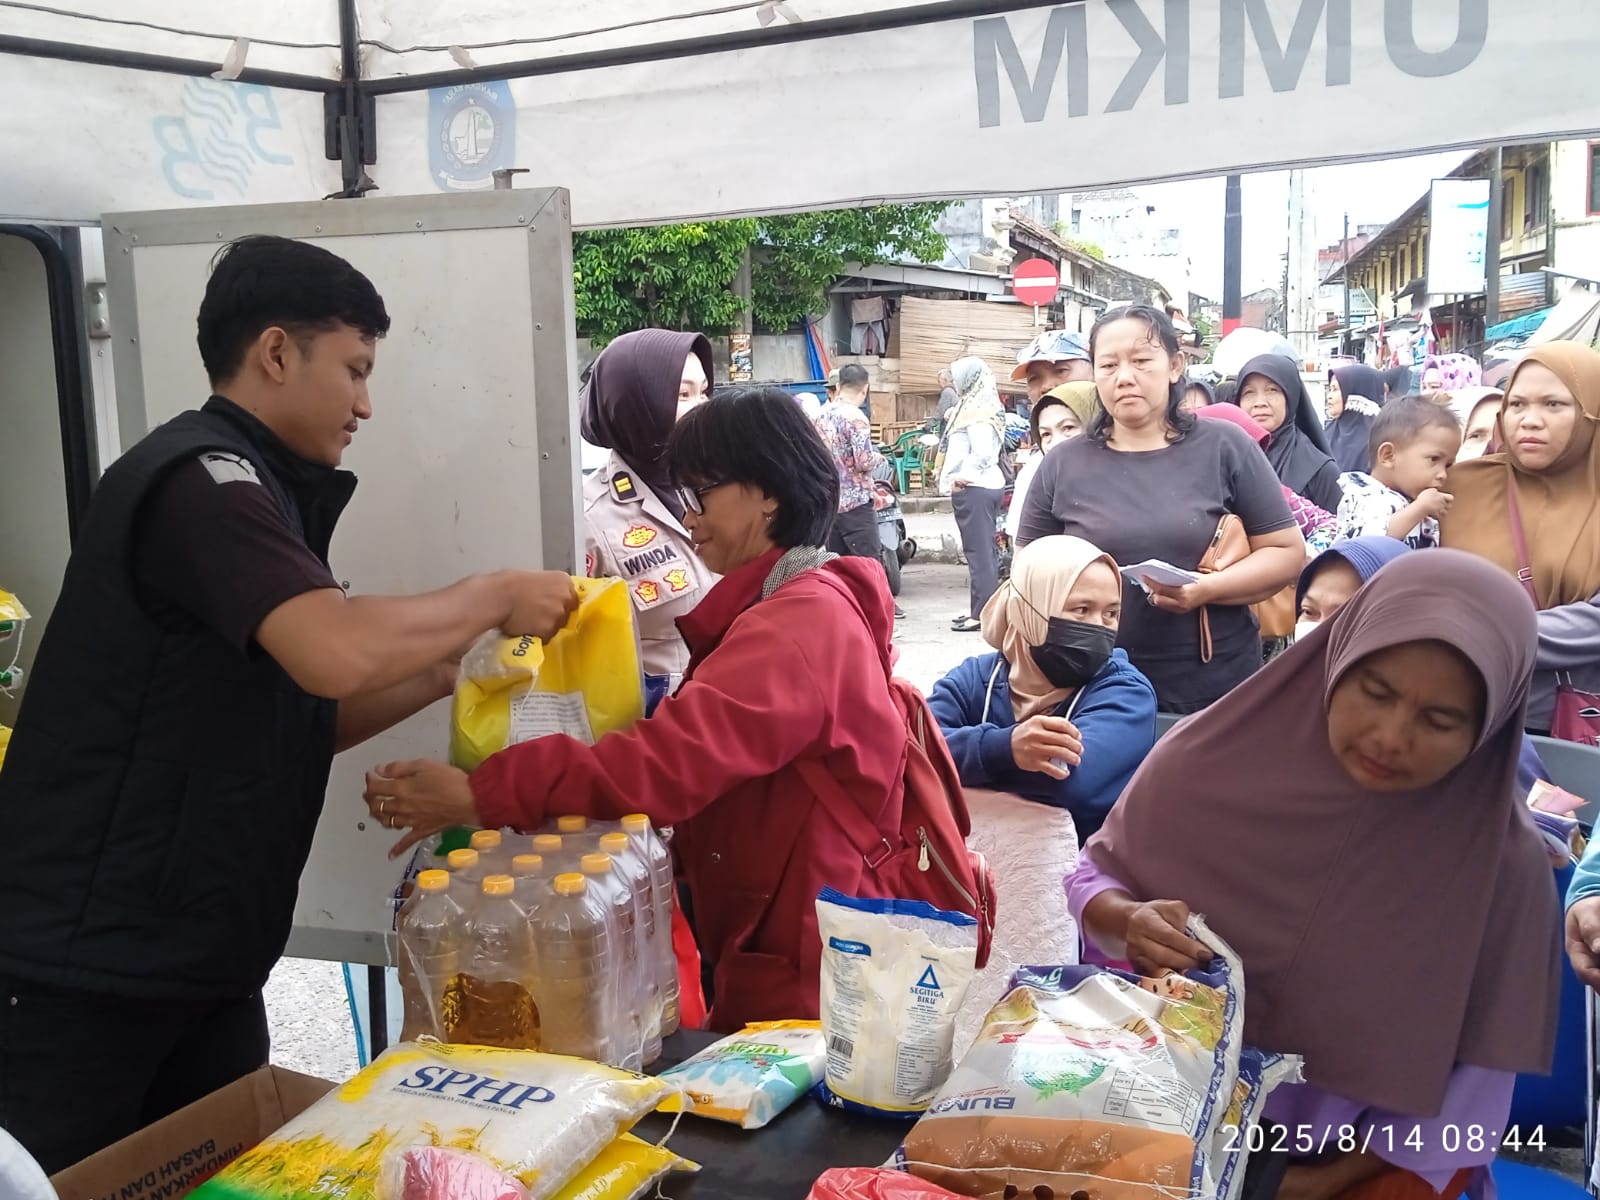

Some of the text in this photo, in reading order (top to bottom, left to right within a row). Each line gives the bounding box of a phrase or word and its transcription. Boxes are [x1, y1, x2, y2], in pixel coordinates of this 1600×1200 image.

[624, 545, 677, 576] WINDA
[512, 633, 535, 657] ulog
[909, 986, 944, 999] SEGITIGA
[917, 996, 936, 1005] BIRU
[398, 1066, 556, 1110] SPHP
[120, 1138, 216, 1200] BASAH DAN
